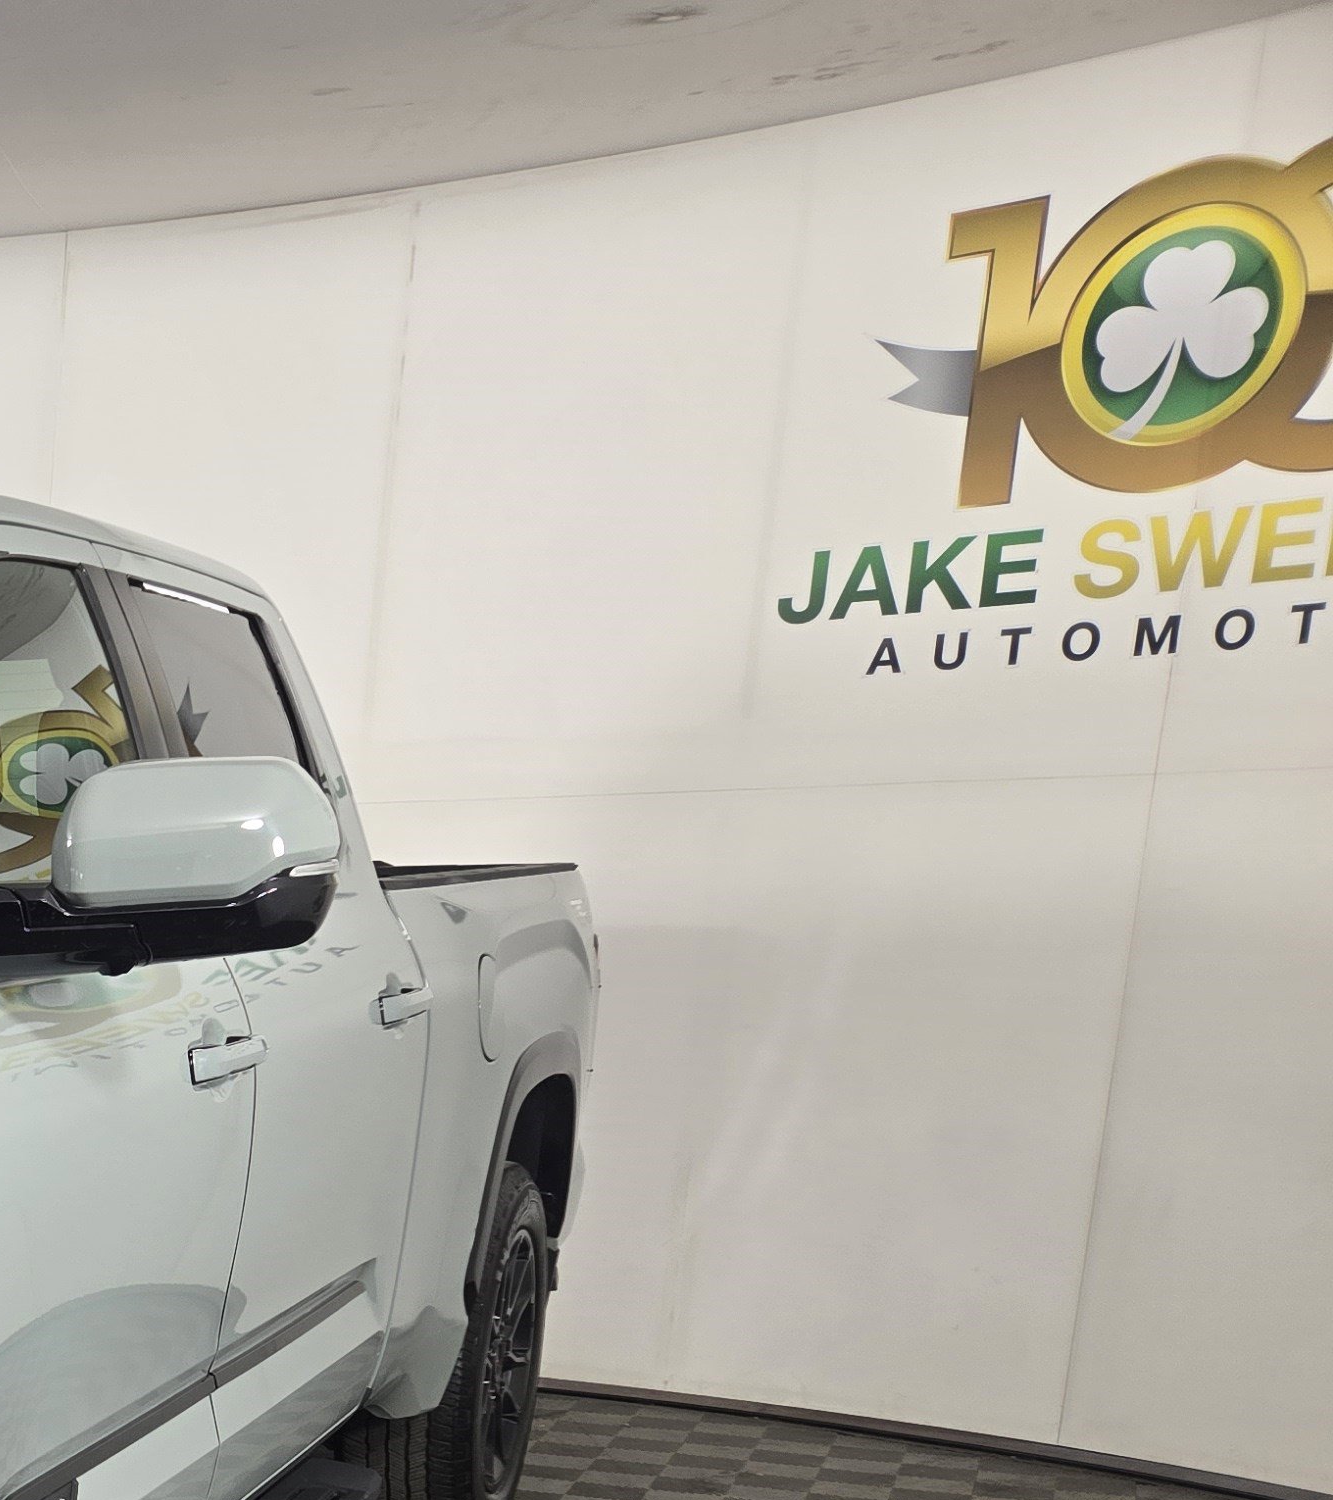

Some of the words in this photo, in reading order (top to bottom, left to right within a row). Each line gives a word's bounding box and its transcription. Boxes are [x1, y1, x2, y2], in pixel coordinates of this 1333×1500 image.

[944, 136, 1333, 509] 10
[777, 527, 1045, 626] JAKE
[1072, 496, 1333, 600] SWE
[865, 602, 1327, 676] AUTOMOT
